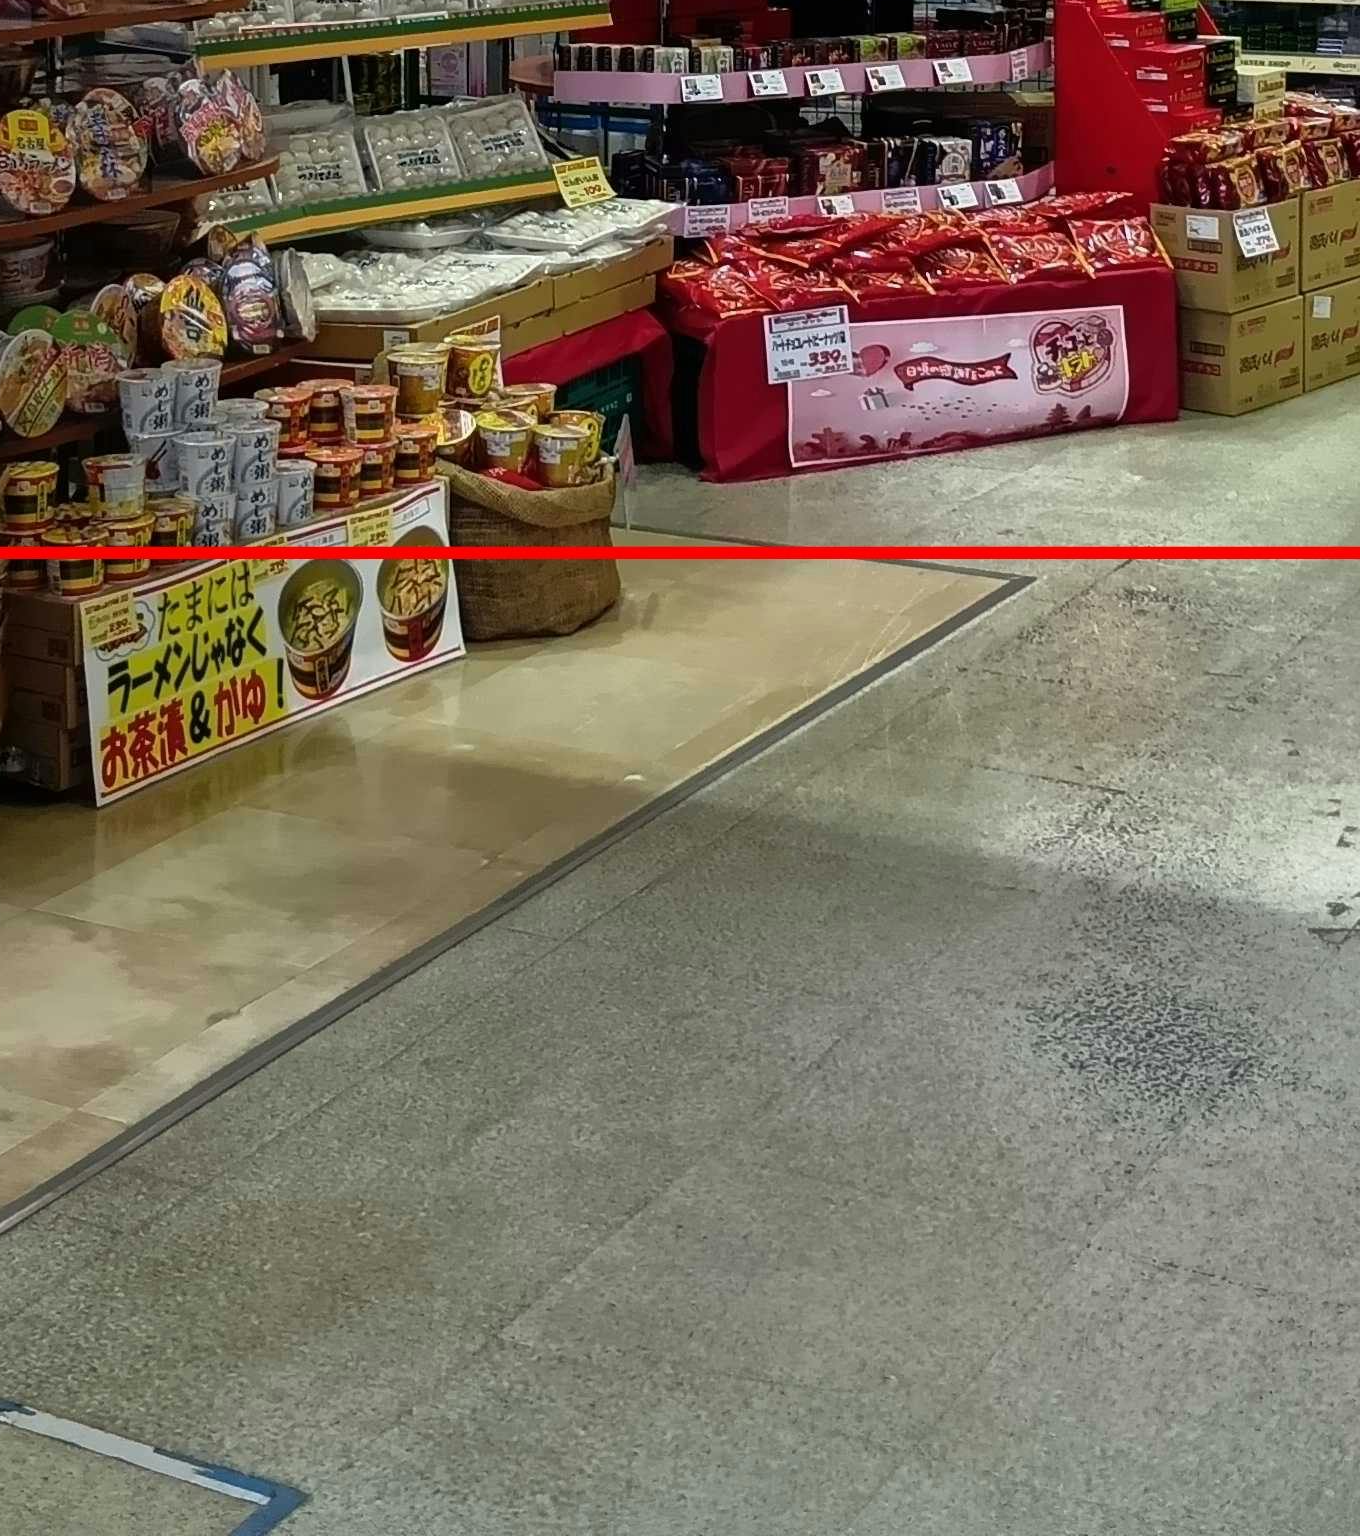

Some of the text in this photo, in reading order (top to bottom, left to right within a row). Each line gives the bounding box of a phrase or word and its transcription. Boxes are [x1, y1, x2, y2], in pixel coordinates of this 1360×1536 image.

[158, 561, 255, 641] たまには
[108, 606, 267, 713] ラーメンじゃなく
